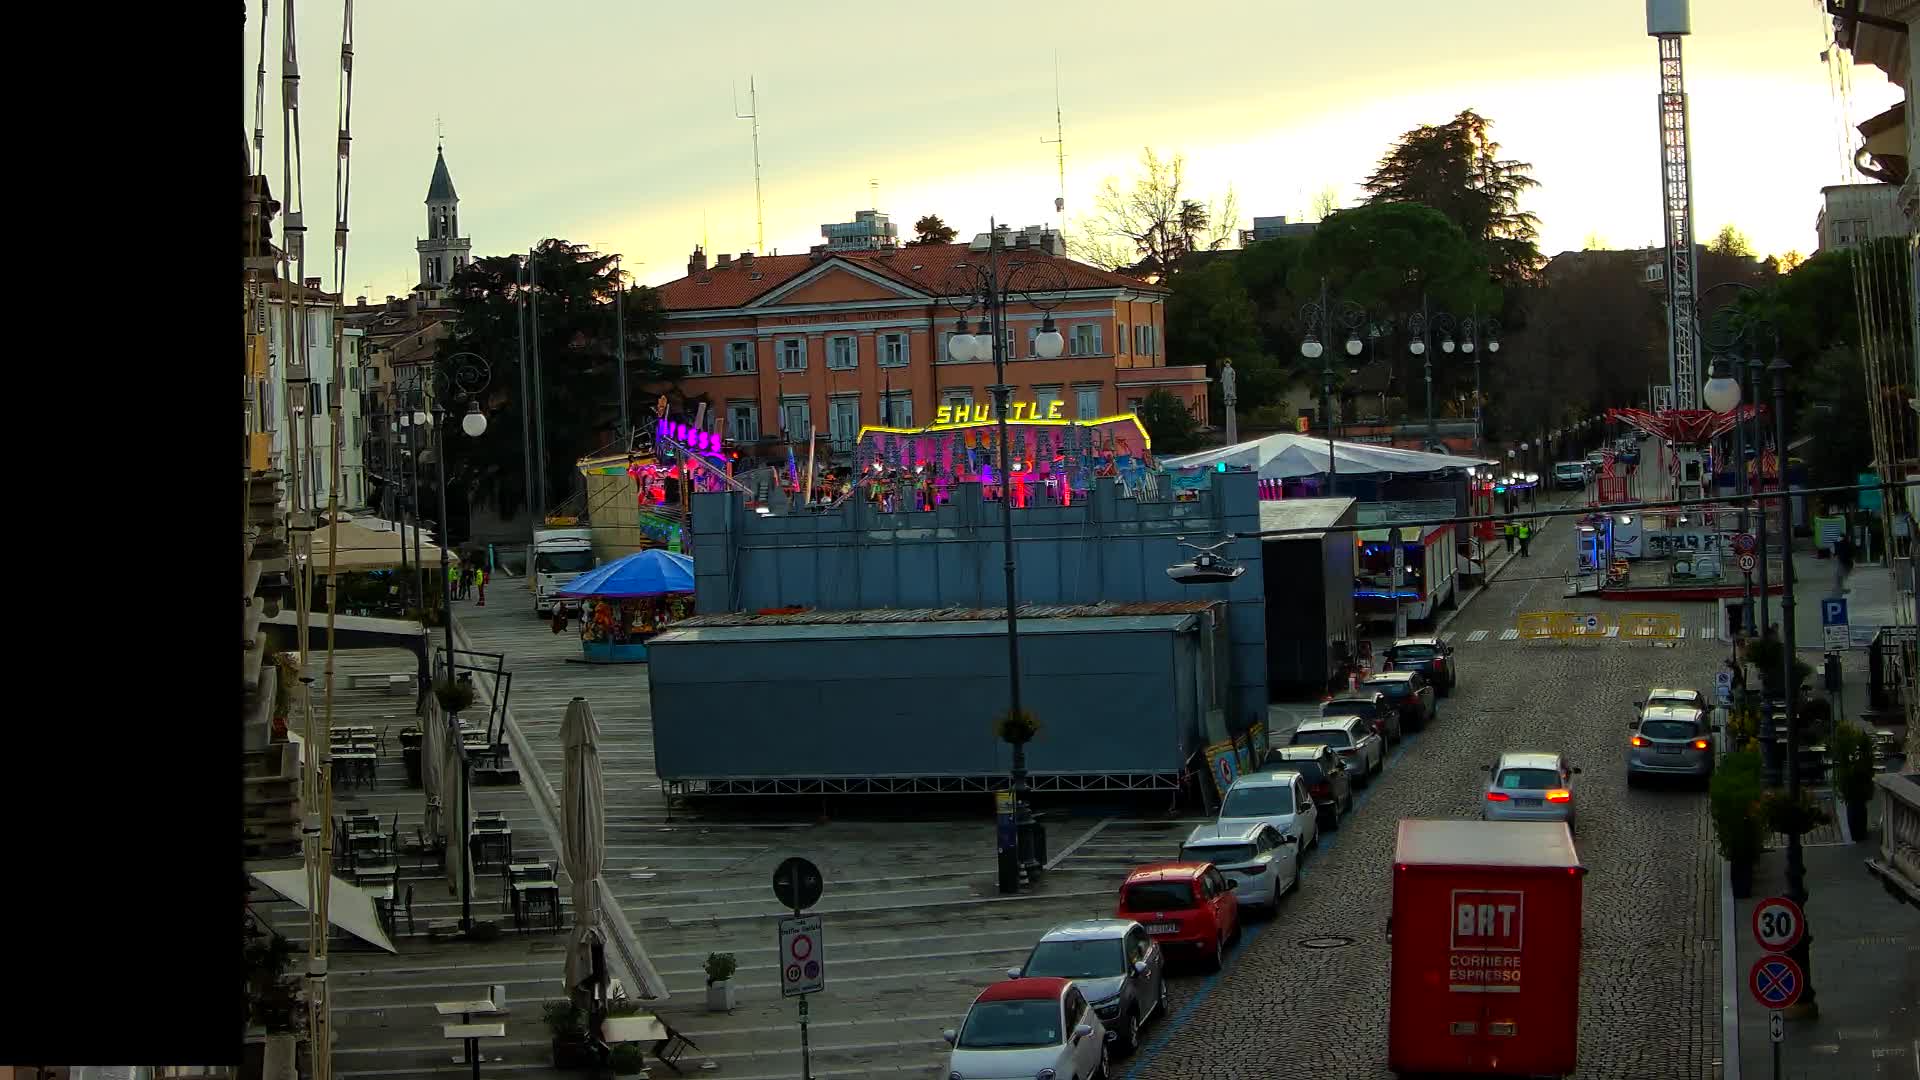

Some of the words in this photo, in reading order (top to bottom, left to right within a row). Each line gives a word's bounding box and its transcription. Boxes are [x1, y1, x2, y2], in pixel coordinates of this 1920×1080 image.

[937, 399, 1065, 424] SHUTLE
[1743, 557, 1752, 567] 20
[1826, 602, 1842, 622] P
[1457, 904, 1517, 937] BRT
[1761, 912, 1792, 938] 30
[1449, 955, 1521, 968] CORRIERE
[1449, 969, 1521, 981] ESPRESSO
